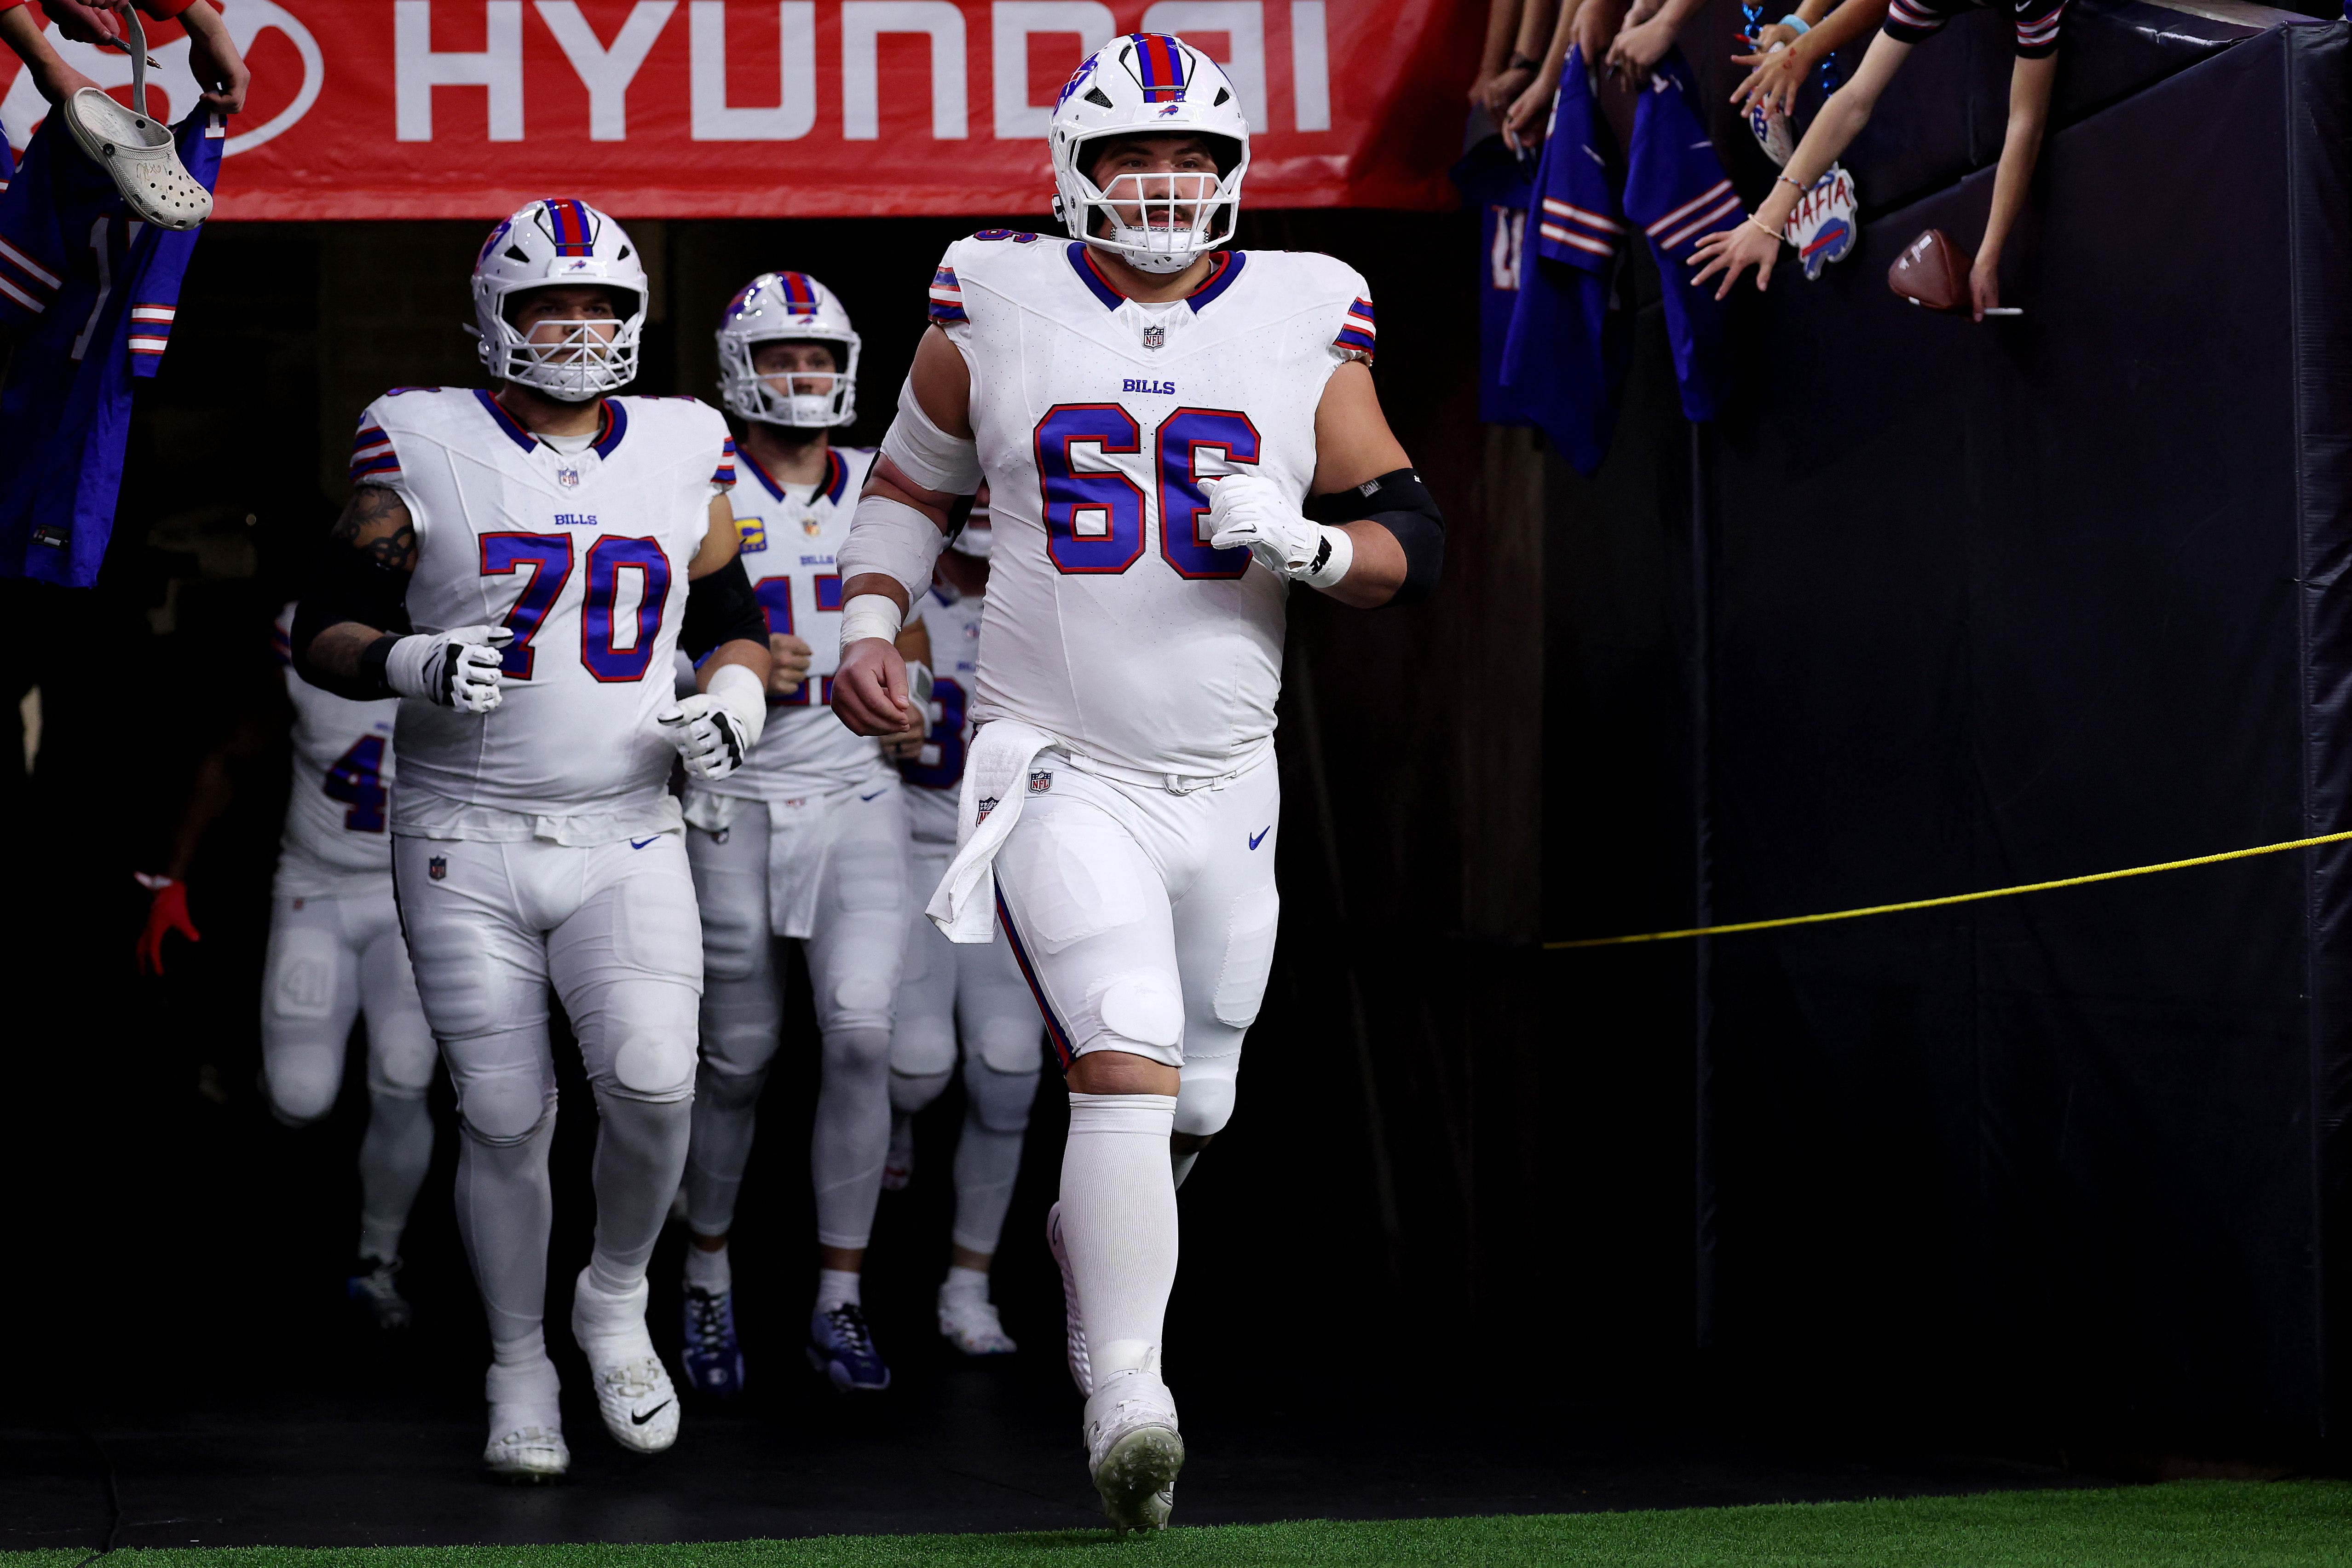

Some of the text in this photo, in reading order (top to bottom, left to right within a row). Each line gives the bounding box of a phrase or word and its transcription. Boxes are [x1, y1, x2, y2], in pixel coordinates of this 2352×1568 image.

[394, 0, 1332, 142] HYUNDAI
[1146, 335, 1162, 346] NFL
[1123, 379, 1175, 395] BILLS
[554, 513, 598, 525] BILLS
[1033, 402, 1262, 581] 66
[478, 532, 671, 683] 70
[324, 734, 386, 833] 4
[1032, 779, 1049, 790] NFL
